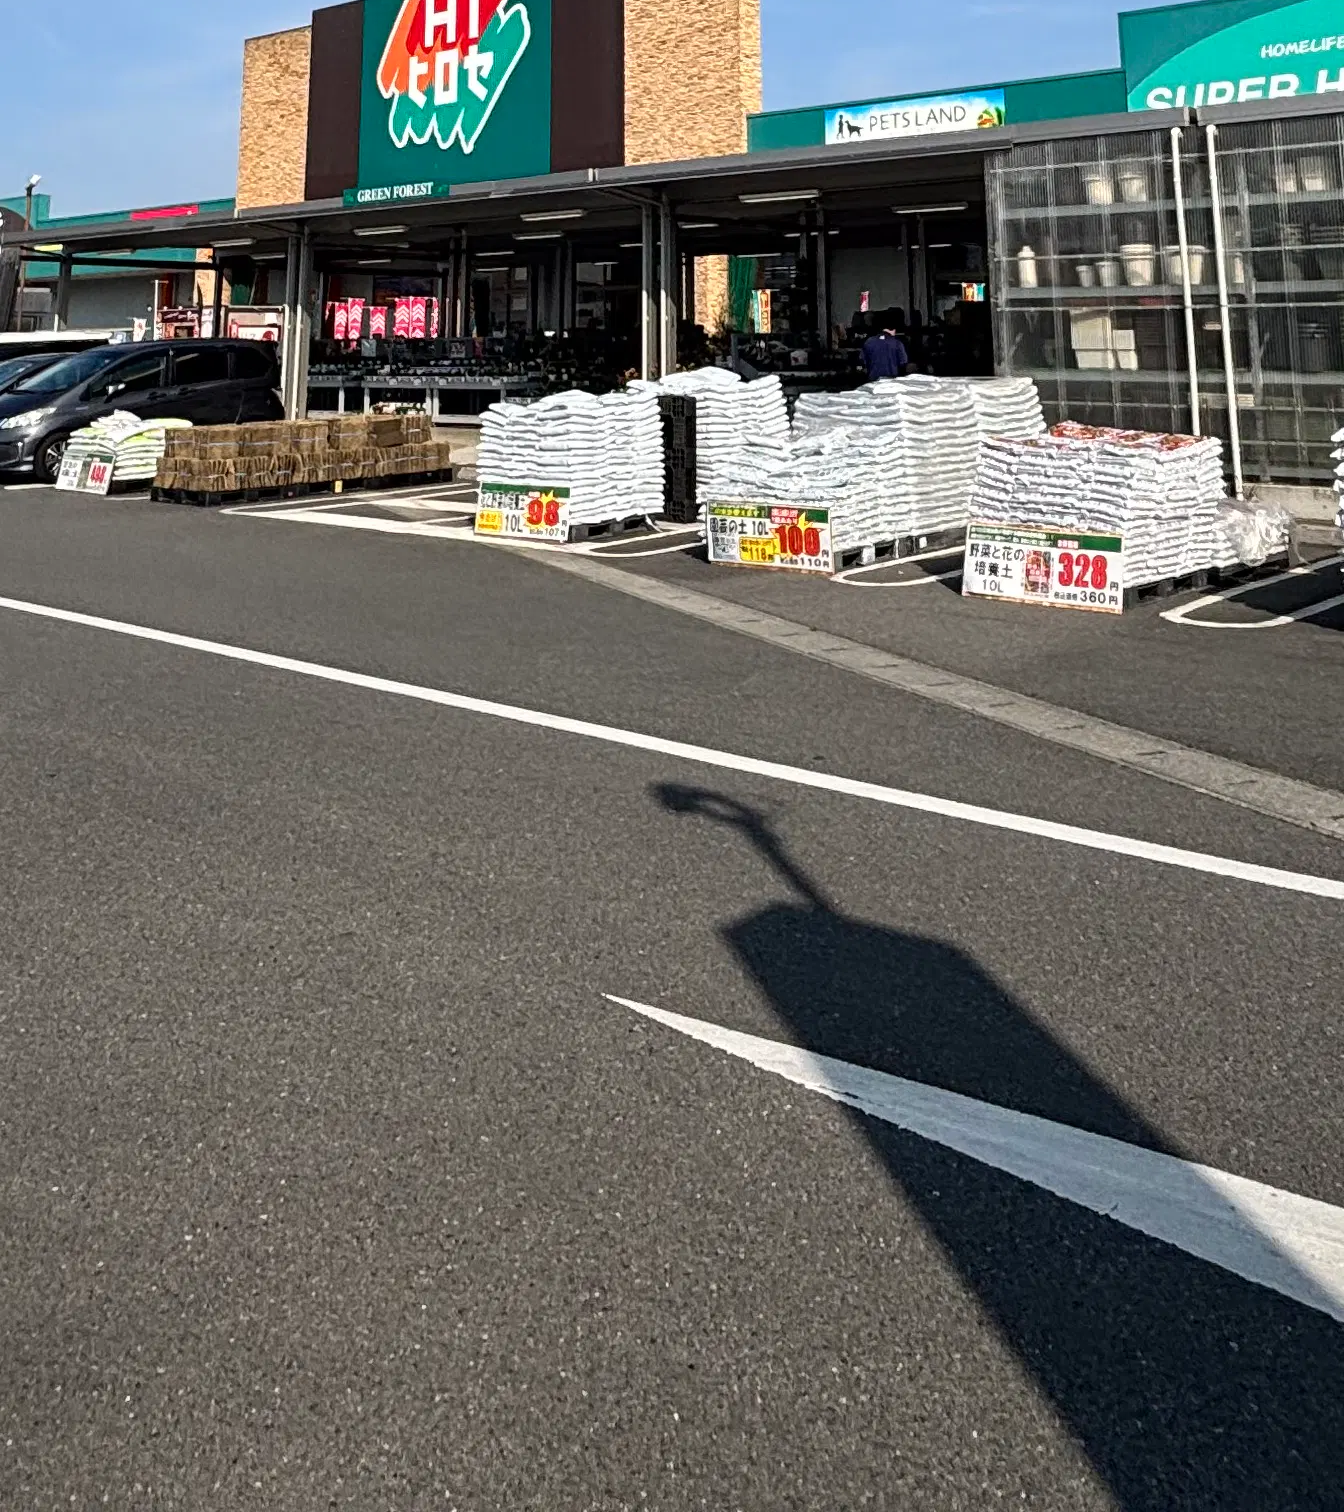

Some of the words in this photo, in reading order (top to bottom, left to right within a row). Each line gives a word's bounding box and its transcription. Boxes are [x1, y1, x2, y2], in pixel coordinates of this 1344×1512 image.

[408, 44, 494, 109] ヒロセ
[357, 187, 391, 203] GREEN
[393, 182, 433, 199] FOREST
[527, 499, 560, 527] 98
[505, 514, 523, 533] 10L
[752, 520, 768, 536] 10L
[776, 524, 821, 557] 100
[968, 543, 1025, 561] 野菜と花の
[974, 560, 1013, 579] 培養土
[1058, 552, 1107, 590] 328
[982, 579, 1004, 593] 10L
